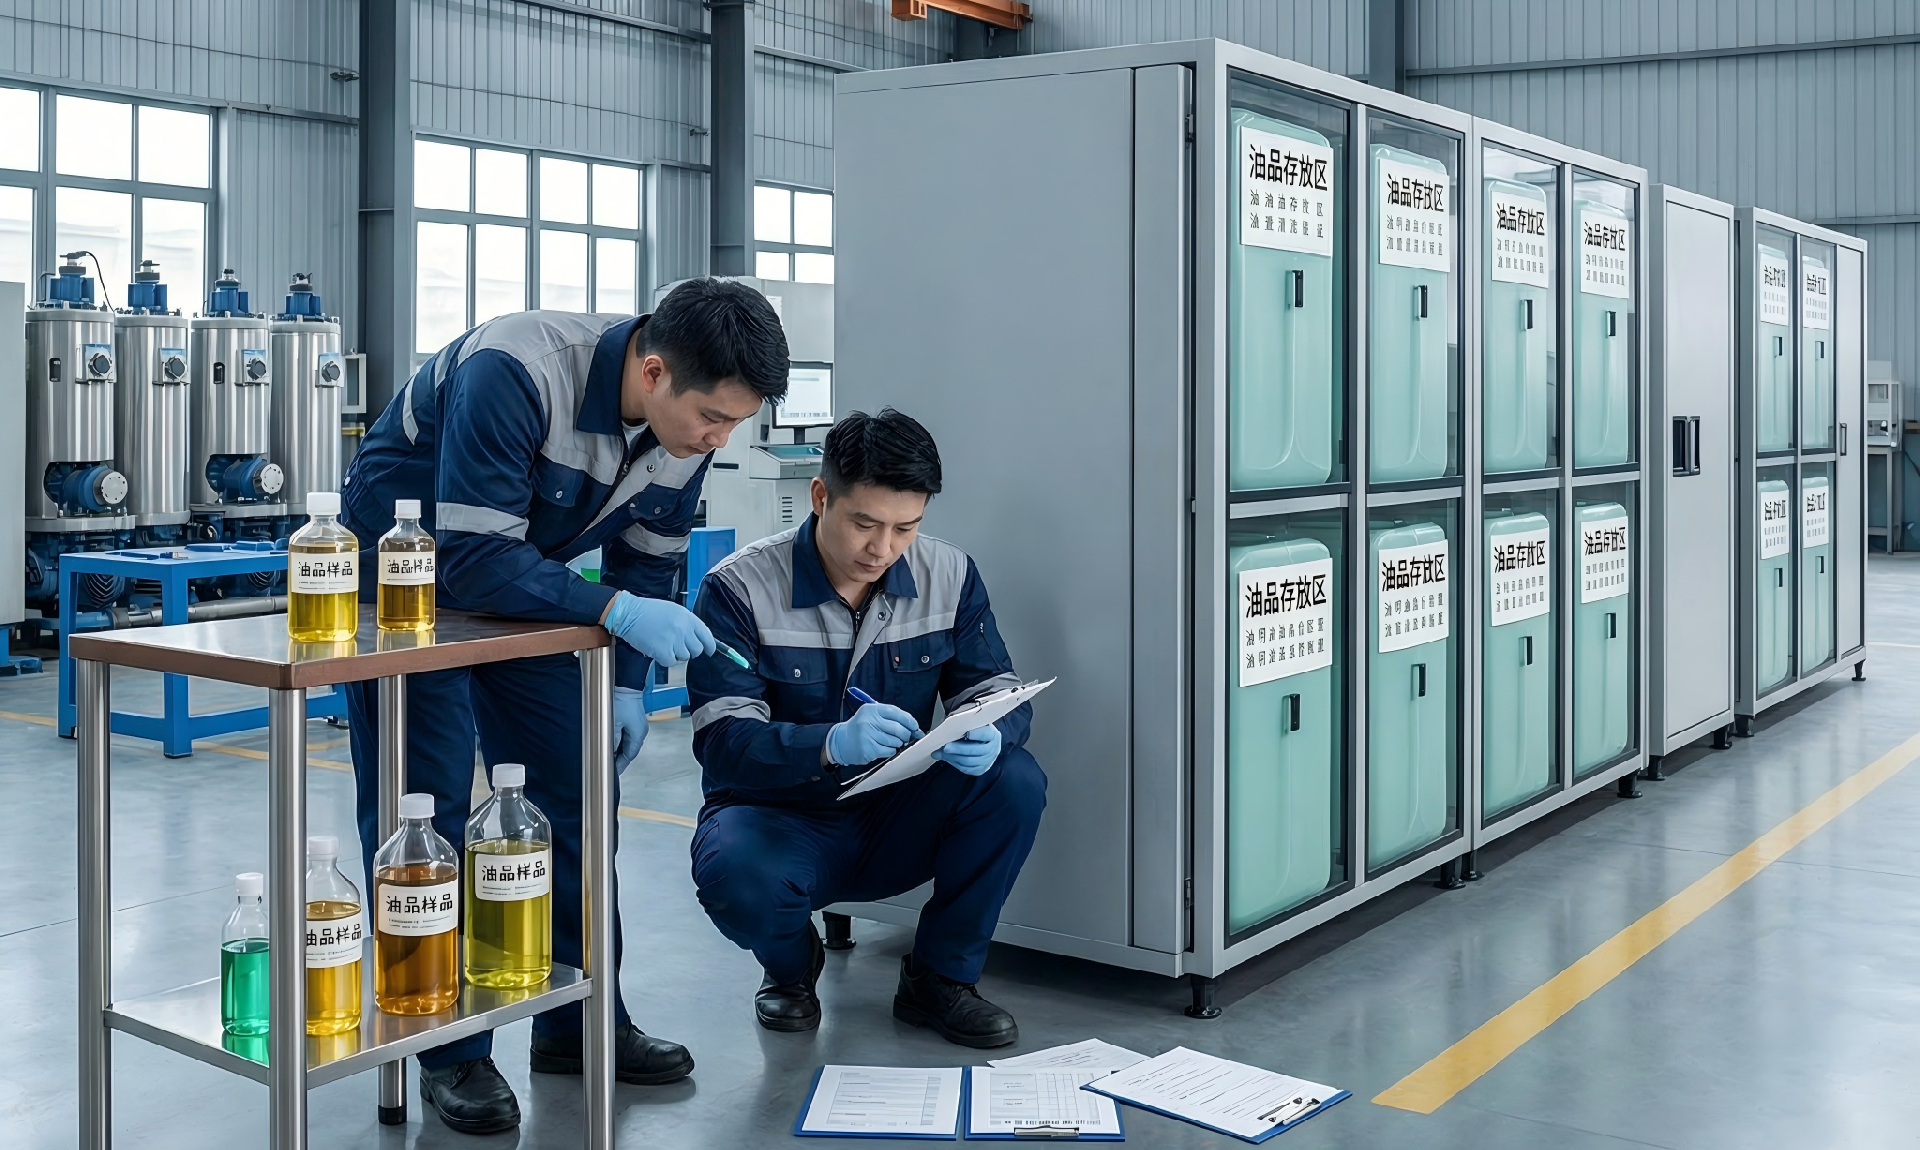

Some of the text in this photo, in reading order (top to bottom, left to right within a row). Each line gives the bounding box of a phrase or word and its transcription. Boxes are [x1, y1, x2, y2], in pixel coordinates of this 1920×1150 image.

[1249, 144, 1327, 191] 油品存放区
[1387, 173, 1444, 212] 油品存放区
[298, 561, 353, 578] 油品样品
[387, 558, 434, 574] 油品样品
[1382, 554, 1446, 592] 油品存放区
[1245, 574, 1327, 618] 油品存放区
[482, 860, 546, 882] 油品样品
[386, 893, 453, 914] 油品样品
